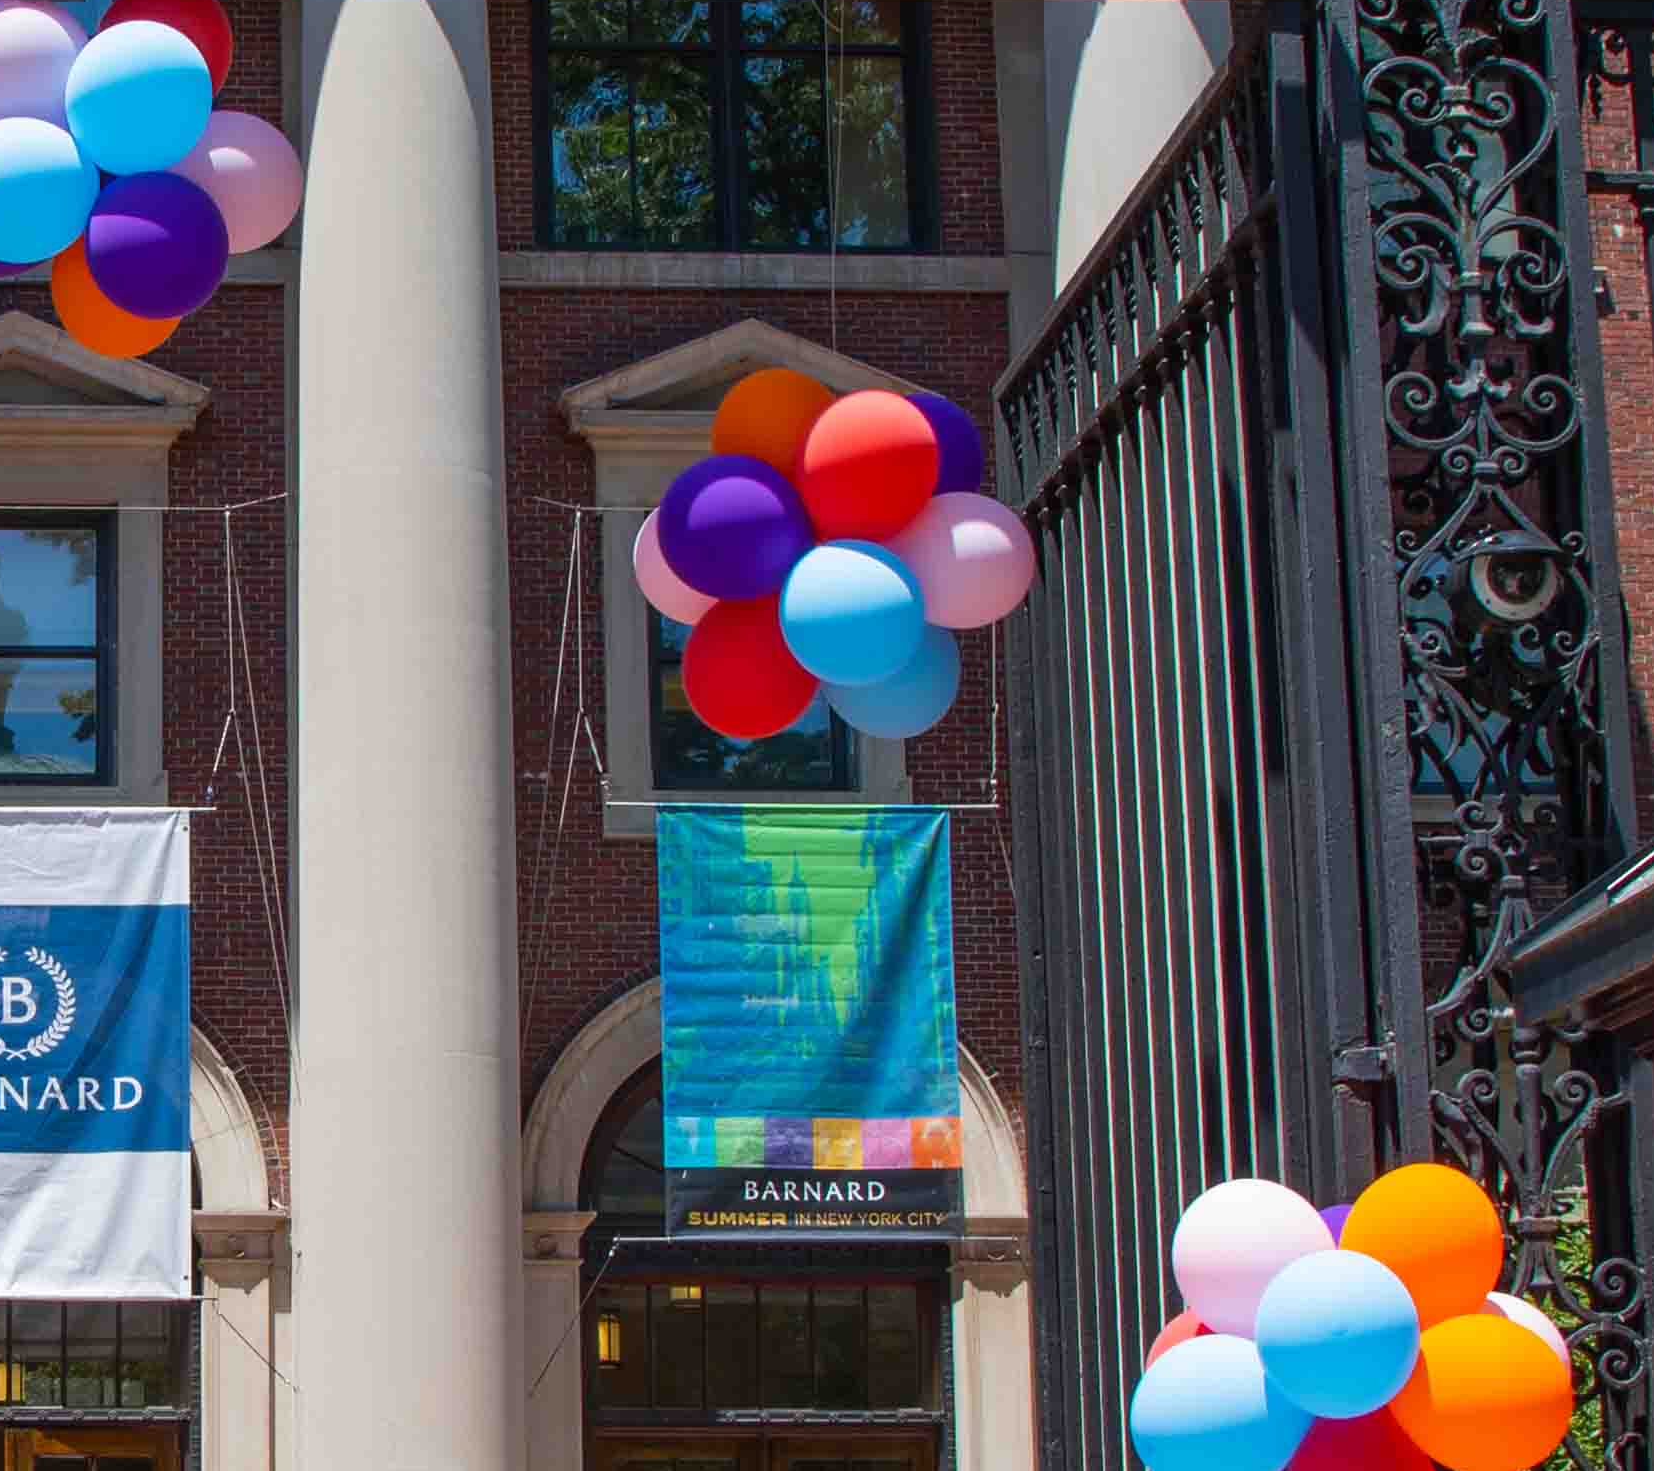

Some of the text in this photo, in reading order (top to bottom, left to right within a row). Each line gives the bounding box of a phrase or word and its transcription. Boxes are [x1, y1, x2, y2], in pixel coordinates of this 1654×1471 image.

[0, 976, 37, 1026] B
[743, 1180, 886, 1202] BARNARD
[687, 1211, 944, 1227] SUMMER IN NEW YORK CITY
